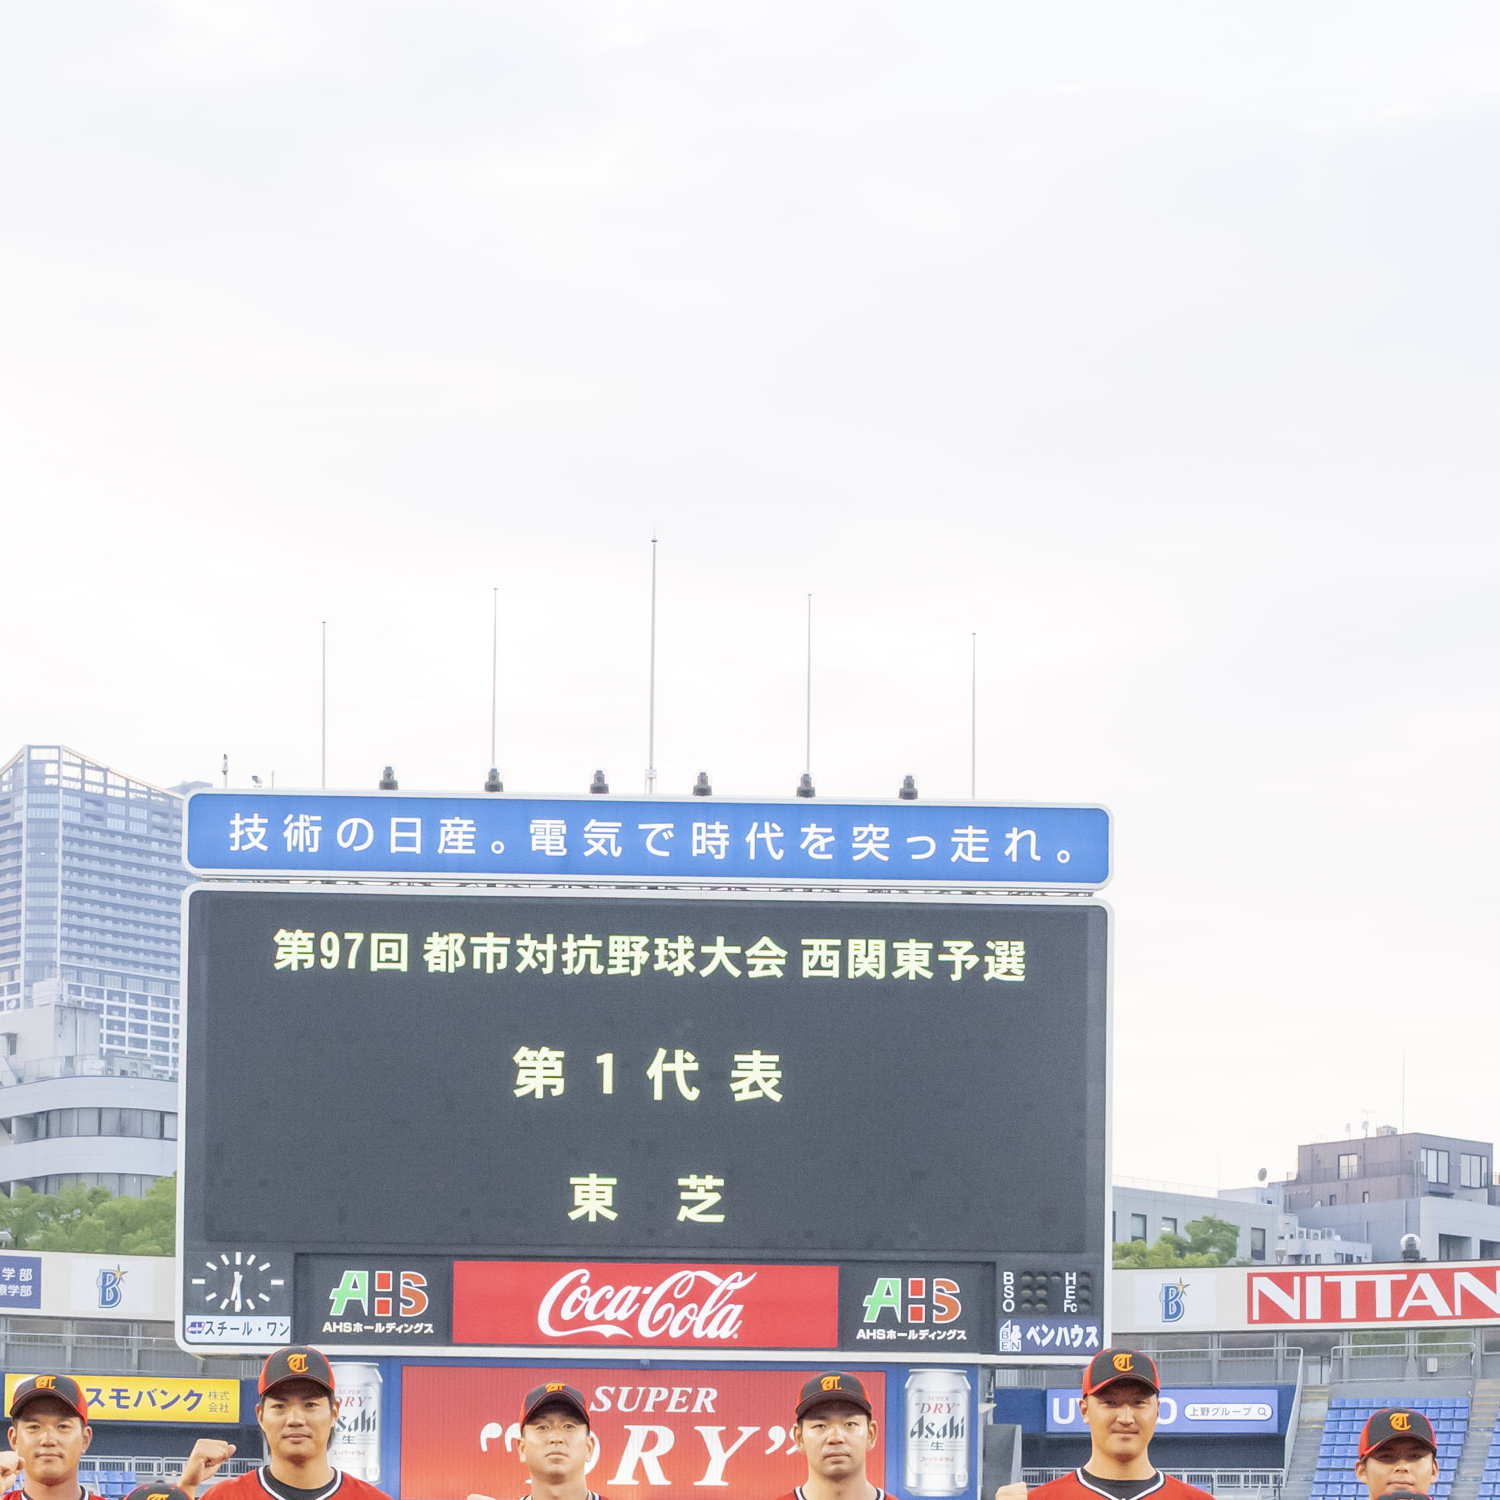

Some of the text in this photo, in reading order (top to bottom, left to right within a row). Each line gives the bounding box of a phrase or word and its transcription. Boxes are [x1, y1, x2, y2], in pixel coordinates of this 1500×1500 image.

[273, 927, 1027, 983] 第97回 都市対抗野球大会 西関東予選
[537, 1268, 758, 1340] Coca-Cola
[322, 1321, 434, 1335] AHSホールディングス
[856, 1328, 967, 1342] AHSホールディングス
[86, 1387, 204, 1412] スモバンク
[589, 1385, 719, 1414] SUPER
[335, 1409, 376, 1432] sahi
[910, 1415, 965, 1440] Asahi
